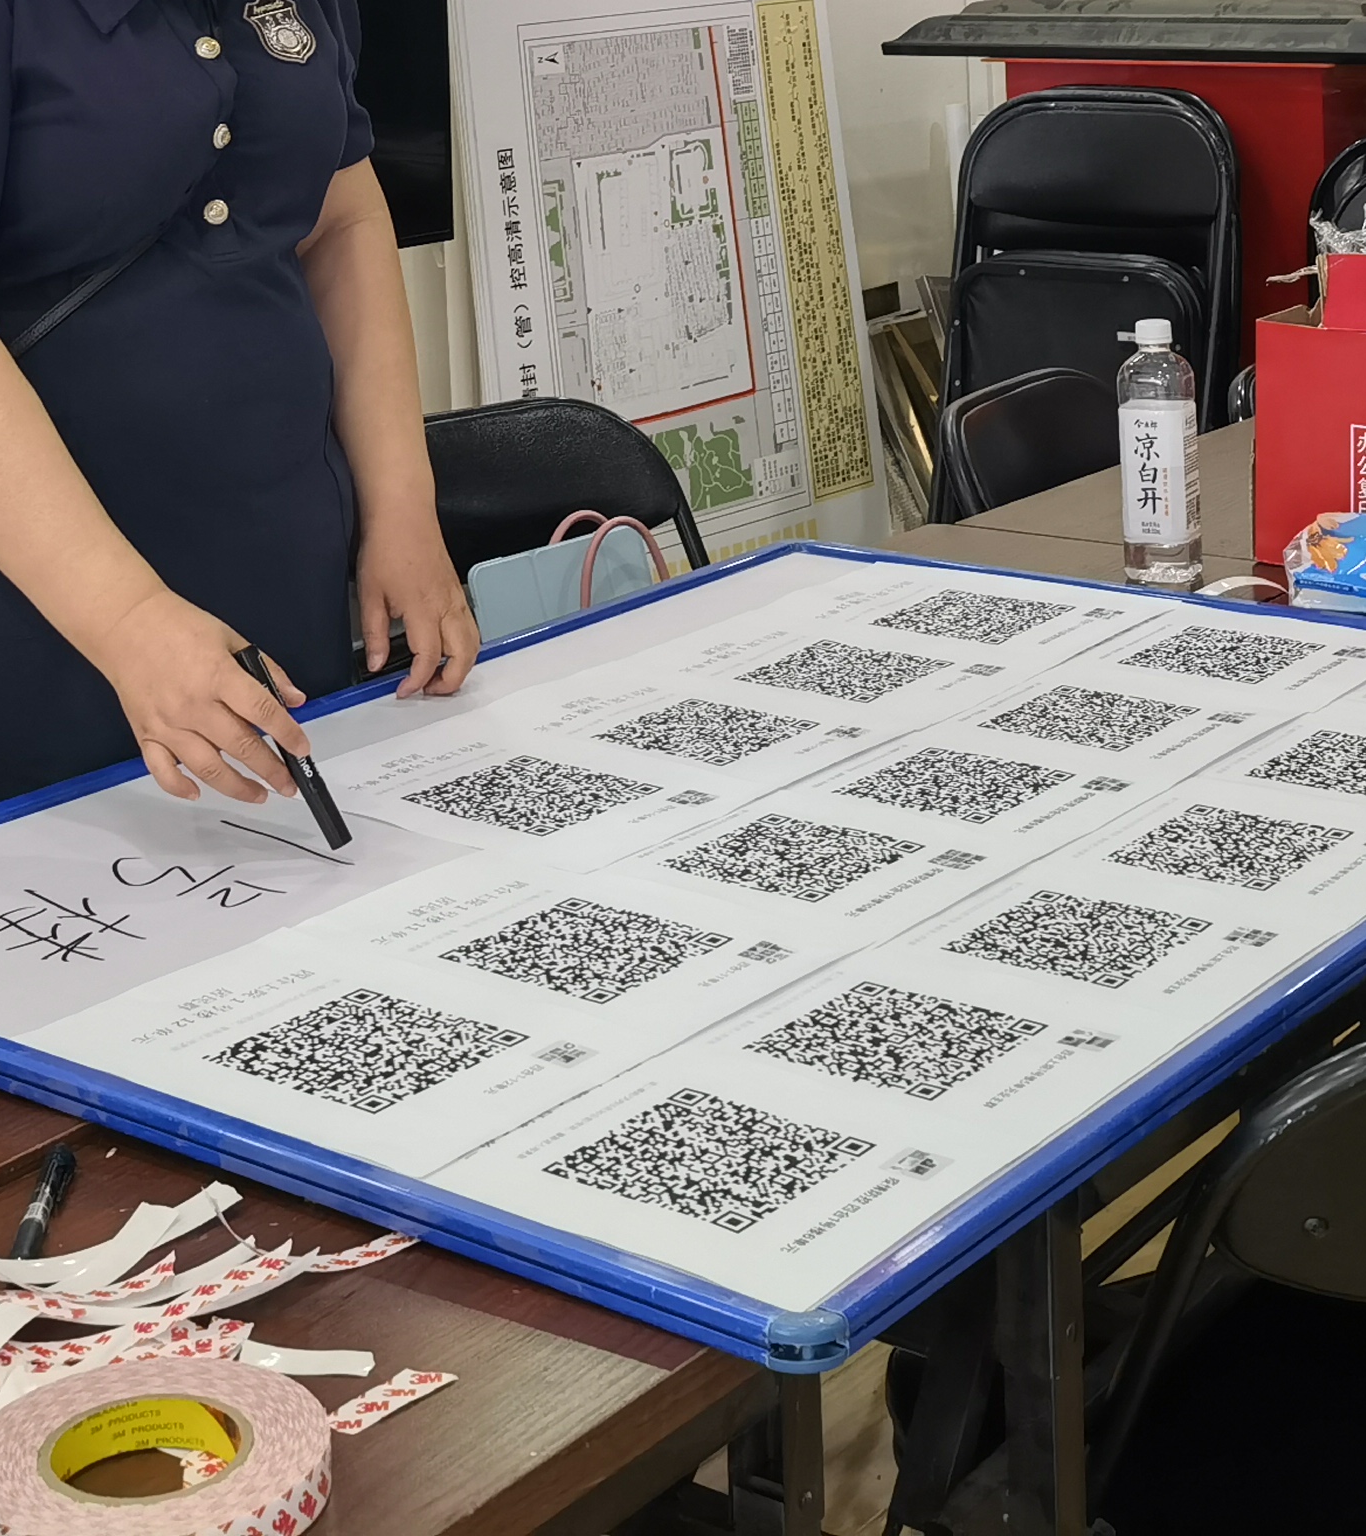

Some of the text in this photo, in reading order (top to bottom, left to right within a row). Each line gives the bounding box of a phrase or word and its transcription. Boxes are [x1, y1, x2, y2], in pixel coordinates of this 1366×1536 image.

[1134, 432, 1163, 515] 凉白开
[357, 1248, 387, 1258] 3M
[223, 1269, 255, 1281] 3M
[192, 1284, 222, 1297] 3M
[162, 1302, 190, 1317] 3M
[134, 1321, 159, 1334] 3M
[409, 1372, 443, 1385] 3M
[382, 1388, 417, 1398] 3M
[356, 1400, 390, 1414] 3M
[331, 1418, 363, 1431] 3M
